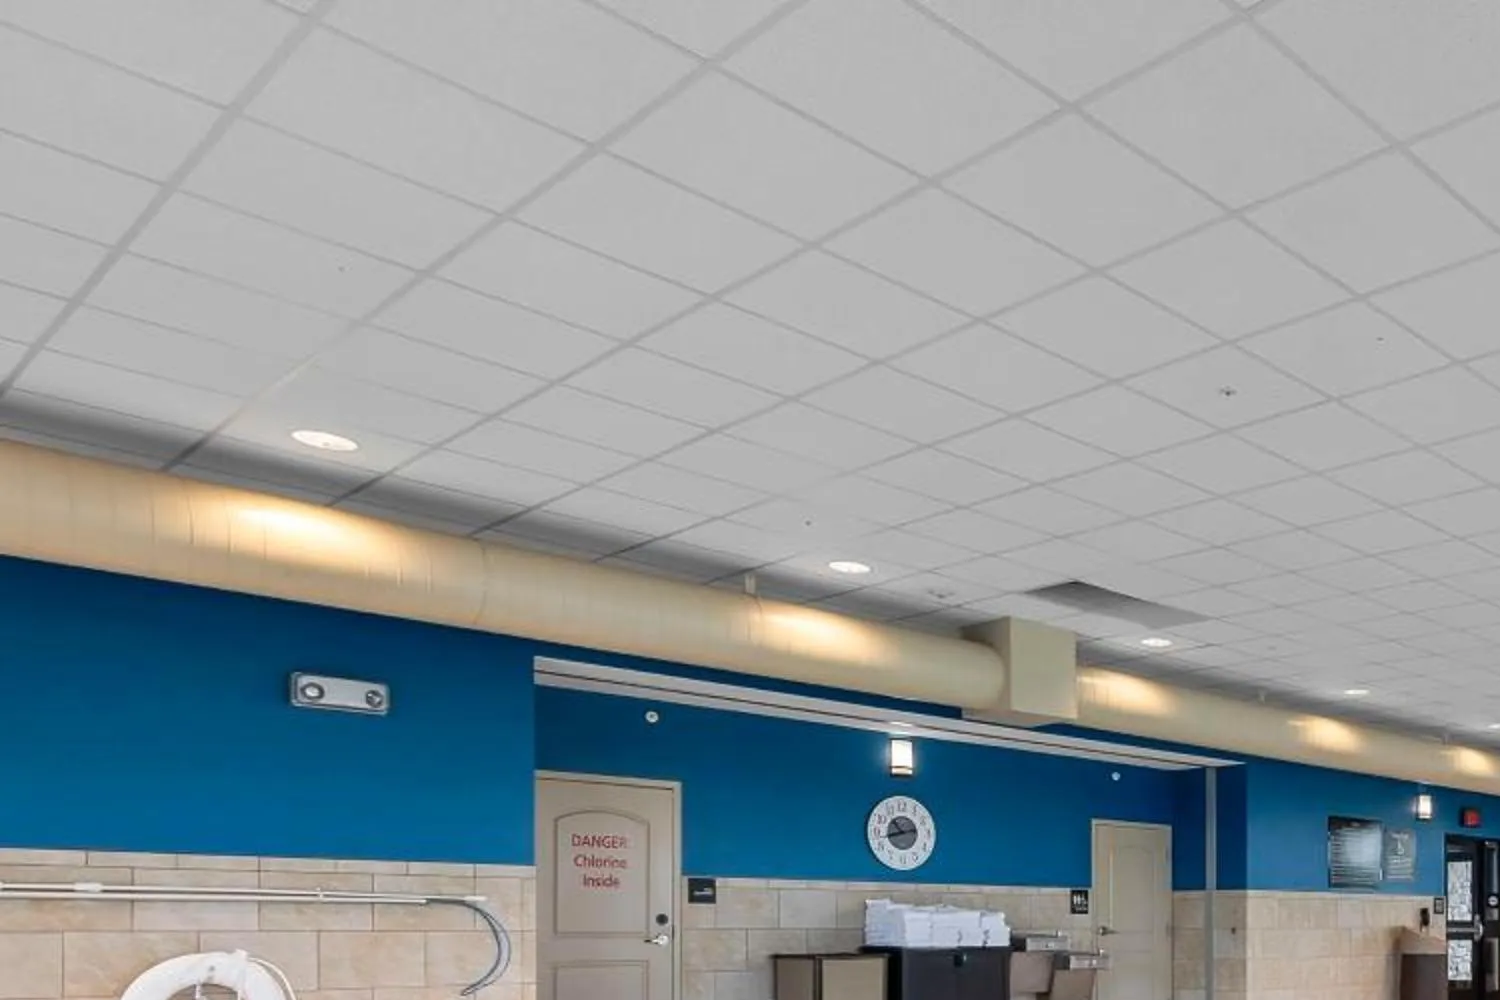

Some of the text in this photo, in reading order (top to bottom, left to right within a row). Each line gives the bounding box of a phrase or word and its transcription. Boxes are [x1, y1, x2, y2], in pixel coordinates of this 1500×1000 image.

[571, 833, 629, 849] DANGER
[573, 853, 628, 870] Chlorine
[583, 874, 621, 889] Inside
